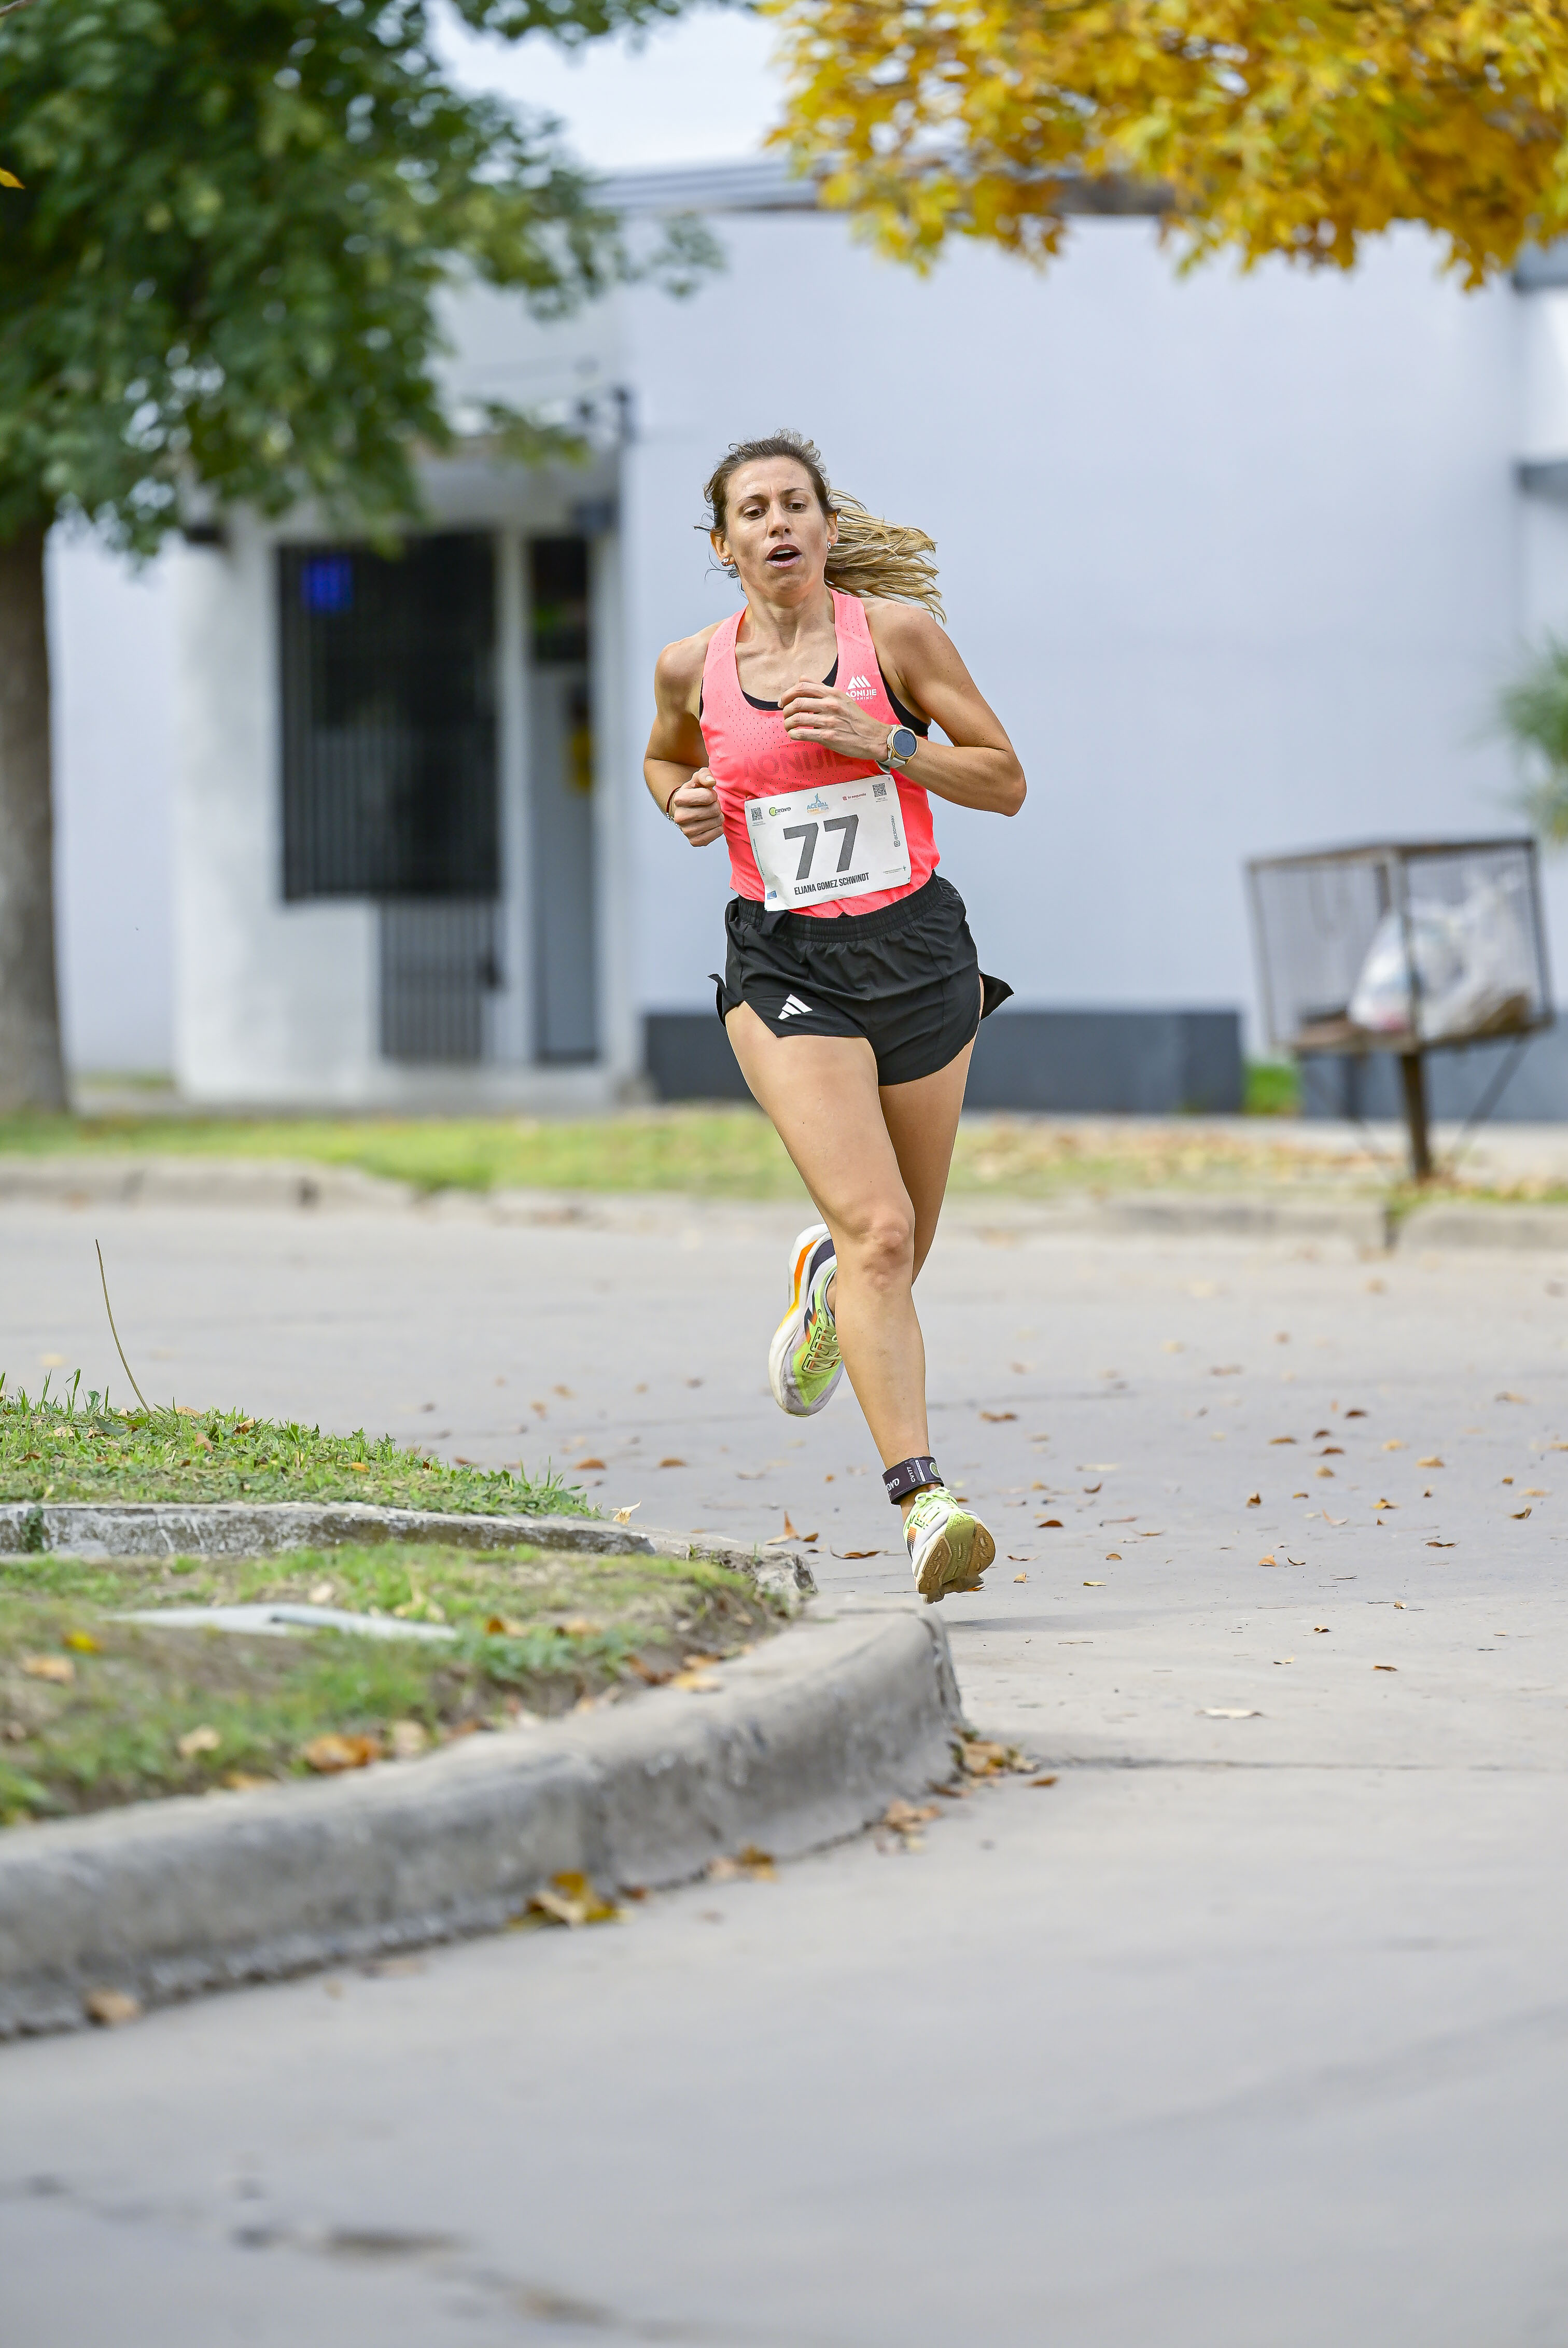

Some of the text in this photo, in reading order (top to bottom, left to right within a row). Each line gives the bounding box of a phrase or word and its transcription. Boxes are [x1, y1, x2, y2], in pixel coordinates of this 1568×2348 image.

[783, 815, 859, 880] 77
[794, 872, 869, 895] ELIANA GOMEZ SCHWINDT
